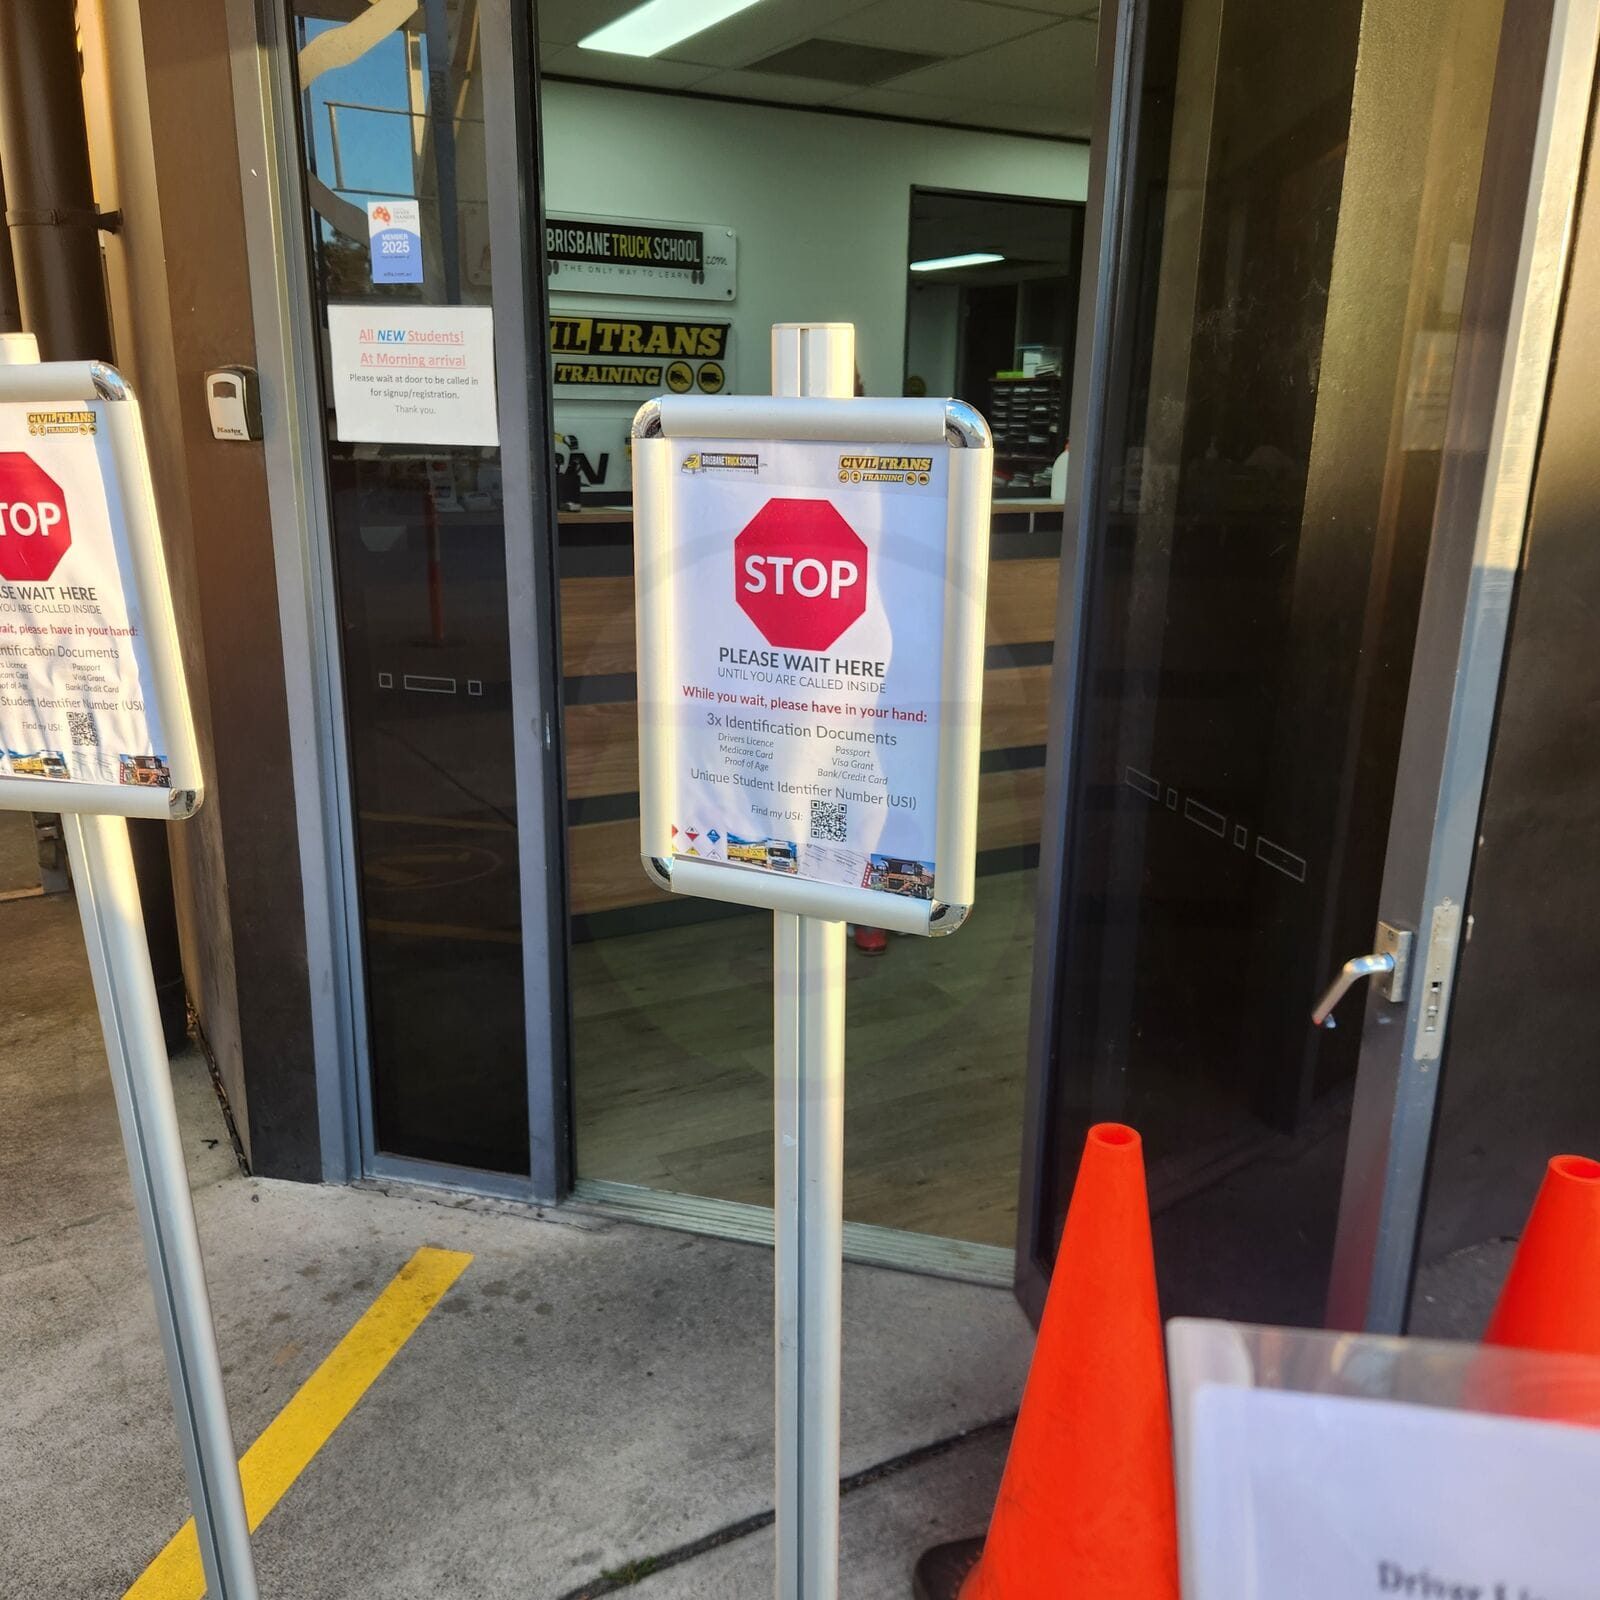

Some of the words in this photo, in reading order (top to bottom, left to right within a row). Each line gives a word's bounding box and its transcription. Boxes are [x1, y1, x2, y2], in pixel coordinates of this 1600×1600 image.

[382, 241, 410, 253] 2025
[546, 228, 611, 256] BRISBANE
[612, 233, 652, 259] TRUCK
[653, 237, 700, 263] SCHOOL
[563, 264, 583, 272] THE
[588, 265, 613, 274] ONLY
[619, 268, 637, 276] WAY
[642, 270, 654, 278] TO
[658, 271, 690, 280] LEARN
[359, 329, 374, 342] All
[378, 330, 406, 342] NEW
[408, 330, 465, 344] Students!
[597, 322, 722, 357] TRANS
[360, 353, 374, 364] At
[377, 353, 426, 368] Morning
[429, 354, 466, 367] arrival
[349, 373, 374, 383] Please
[376, 374, 393, 383] wait
[395, 375, 403, 384] at
[405, 375, 422, 384] door
[424, 376, 433, 385] to
[435, 376, 445, 385] be
[446, 376, 470, 386] called
[471, 376, 479, 386] in
[557, 365, 660, 385] TRAINING
[370, 387, 382, 397] for
[383, 388, 460, 400] signup/registration.
[28, 414, 55, 423] CIVIL
[57, 412, 94, 423] TRANS
[395, 405, 418, 415] Thank
[420, 408, 436, 418] you.
[840, 457, 877, 469] CIVIL
[879, 458, 931, 471] TRANS
[863, 474, 903, 482] TRAINING
[0, 502, 61, 536] TOP
[744, 554, 858, 599] STOP
[17, 586, 55, 600] WAIT
[60, 587, 97, 600] HERE
[18, 604, 33, 613] ARE
[34, 604, 70, 614] CALLED
[73, 604, 102, 614] INSIDE
[20, 624, 48, 635] please
[50, 624, 72, 634] have
[75, 624, 84, 634] in
[86, 626, 108, 636] your
[109, 626, 138, 636] hand:
[57, 646, 119, 658] Documents
[72, 663, 100, 671] Passport
[719, 647, 779, 668] PLEASE
[783, 654, 830, 674] WAIT
[836, 658, 885, 678] HERE
[718, 667, 749, 681] UNTIL
[750, 670, 774, 683] YOU
[775, 674, 796, 686] ARE
[799, 676, 843, 690] CALLED
[847, 680, 886, 694] INSIDE
[104, 685, 119, 693] Card
[37, 697, 80, 708] Identifier
[83, 698, 118, 710] Number
[682, 685, 715, 700] While
[717, 692, 737, 705] you
[739, 694, 768, 709] wait,
[770, 696, 809, 712] please
[811, 701, 842, 715] have
[845, 703, 857, 716] in
[860, 707, 889, 721] your
[892, 707, 928, 723] hand:
[22, 721, 37, 730] Find
[706, 713, 722, 727] 3x
[725, 715, 812, 738] Identification
[816, 725, 897, 746] Documents
[718, 733, 745, 744] Drivers
[746, 736, 774, 748] Licence
[719, 744, 754, 757] Medicare
[755, 749, 774, 760] Card
[835, 746, 870, 758] Passport
[724, 757, 745, 768] Proof
[746, 759, 754, 769] of
[754, 761, 769, 772] Age
[832, 757, 849, 768] Visa
[851, 759, 874, 771] Grant
[817, 768, 867, 783] Bank/Credit
[868, 774, 888, 785] Card
[690, 767, 730, 786] Unique
[733, 774, 774, 792] Student
[777, 780, 832, 798] Identifier
[835, 787, 883, 805] Number
[886, 794, 917, 810] (USI)
[751, 804, 768, 816] Find
[769, 810, 783, 820] my
[784, 809, 803, 821] USI:
